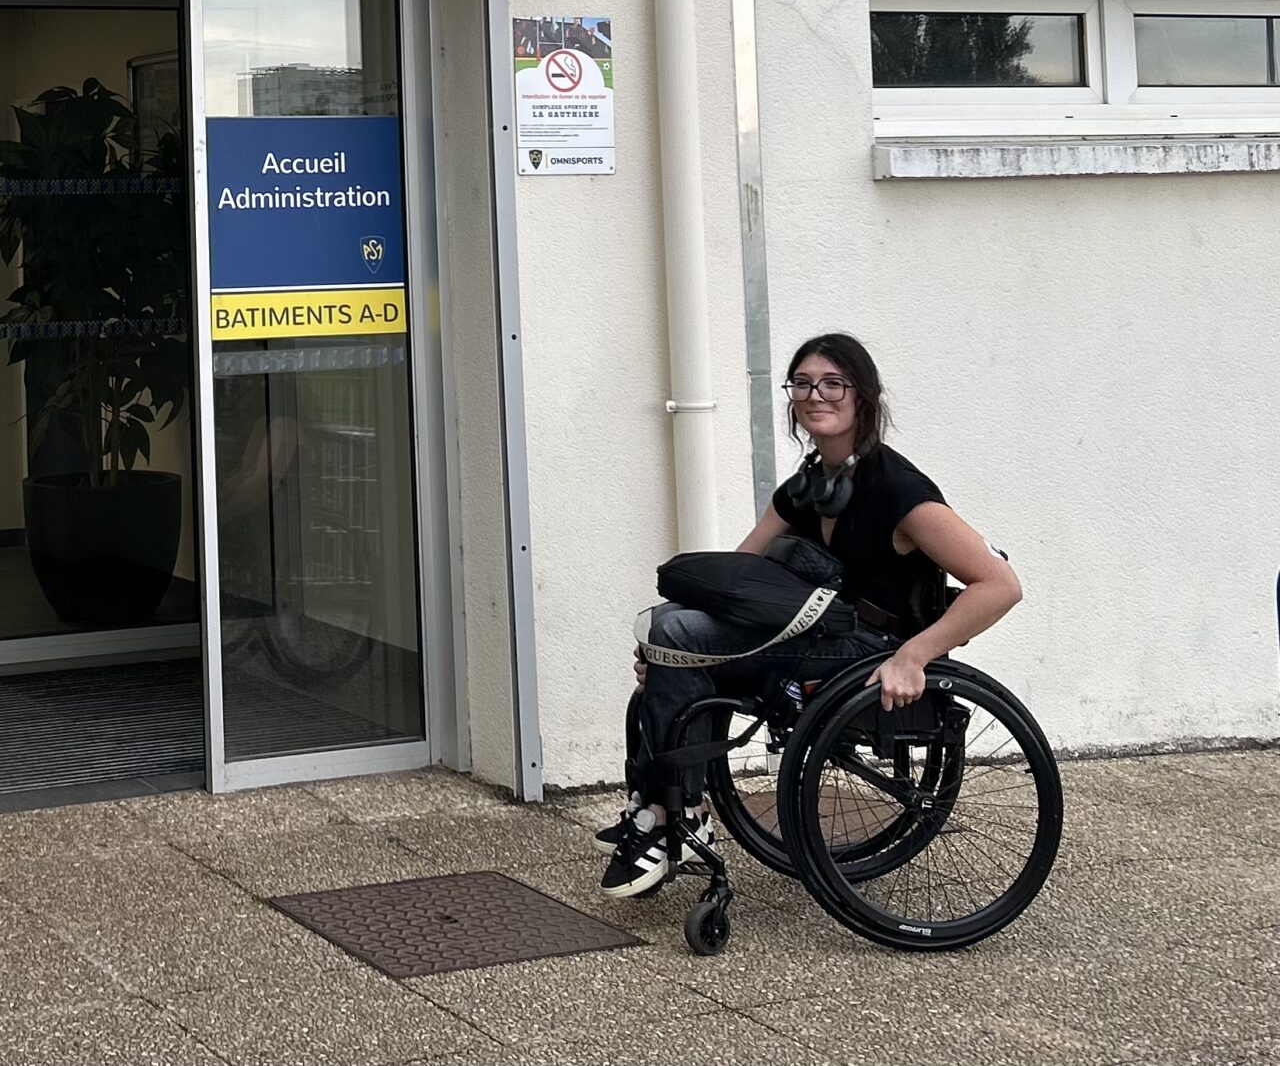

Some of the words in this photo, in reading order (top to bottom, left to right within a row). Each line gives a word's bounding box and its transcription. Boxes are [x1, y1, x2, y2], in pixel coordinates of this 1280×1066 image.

[261, 152, 346, 174] Accueil
[550, 157, 604, 165] OMNISPORTS
[218, 185, 390, 209] Administration
[215, 304, 352, 329] BATIMENTS
[359, 303, 399, 323] A-D
[645, 647, 689, 665] GUESS
